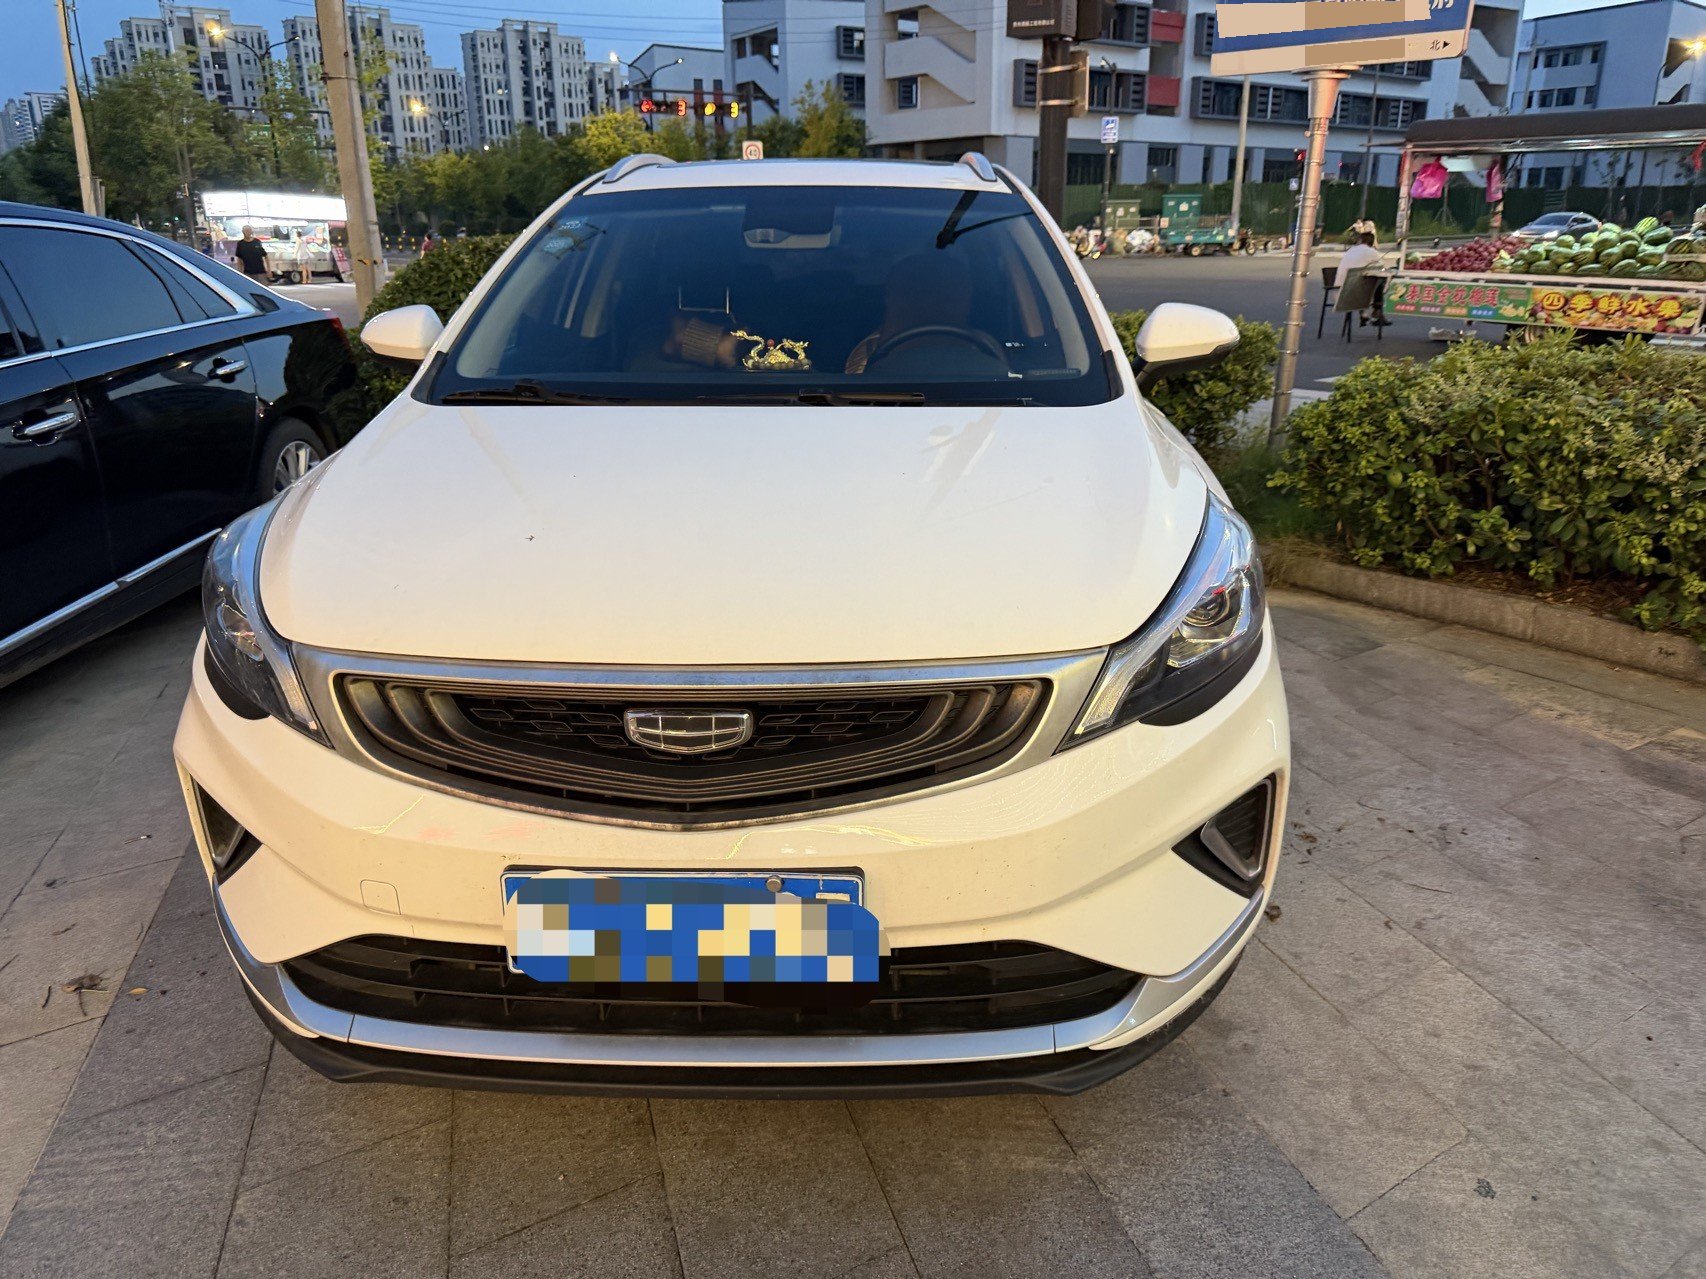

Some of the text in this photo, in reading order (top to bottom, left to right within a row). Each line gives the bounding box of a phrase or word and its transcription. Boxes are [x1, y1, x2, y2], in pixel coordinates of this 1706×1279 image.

[1429, 39, 1441, 51] 北
[1405, 283, 1500, 308] 泰国金枕榴莲
[1542, 291, 1683, 320] 四季鲜水果
